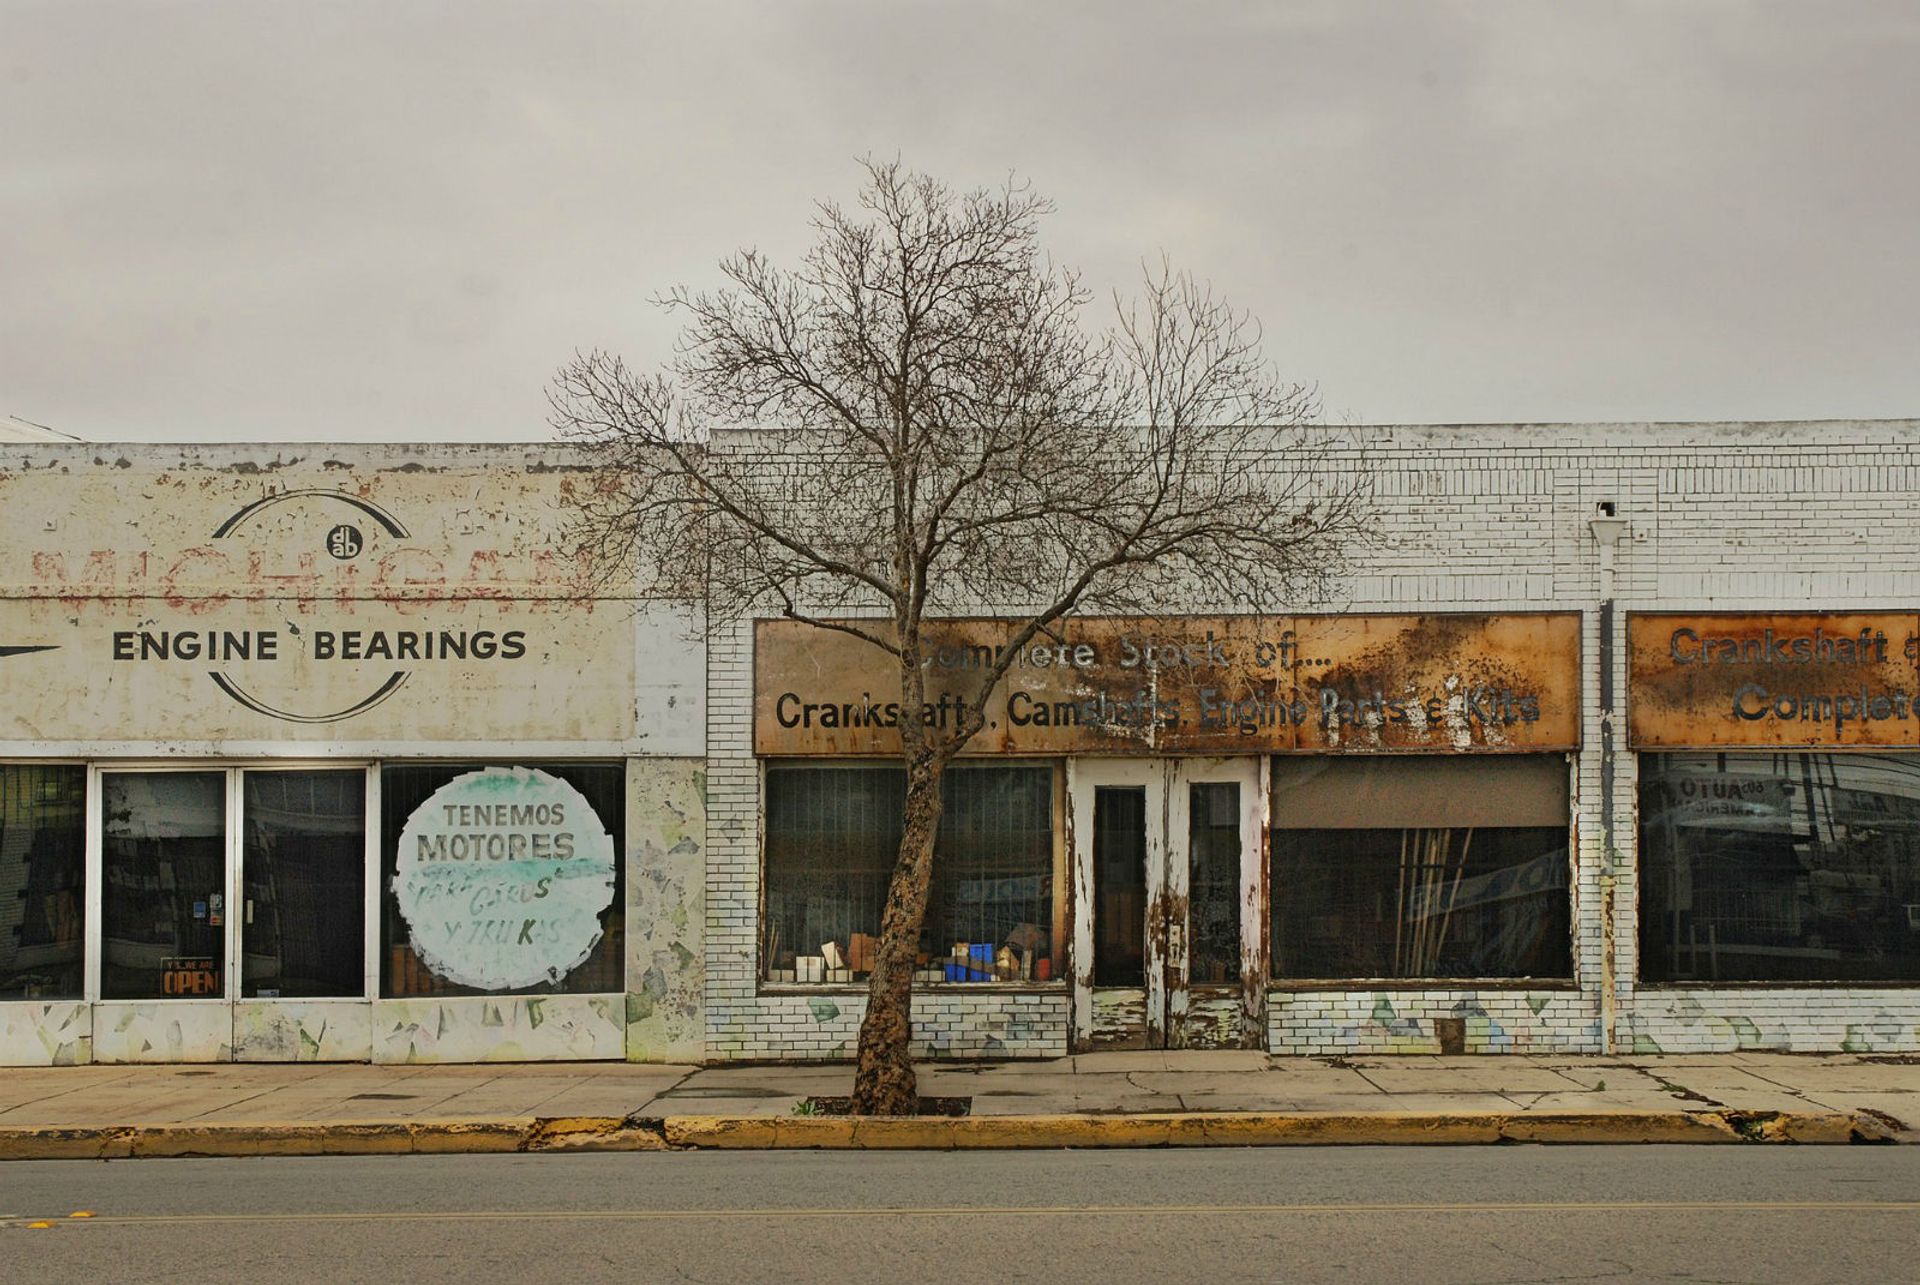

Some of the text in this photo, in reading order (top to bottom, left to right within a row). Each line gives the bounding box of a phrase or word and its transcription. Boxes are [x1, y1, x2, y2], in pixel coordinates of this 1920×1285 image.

[113, 631, 527, 660] ENGINE BEARINGS
[914, 636, 1095, 669] omlete
[1120, 631, 1230, 669] Stock
[1670, 627, 1888, 665] Crankshaft
[776, 691, 997, 730] Cranksaft,
[1202, 687, 1307, 735] Engine
[1320, 687, 1408, 727] Parts
[1462, 686, 1540, 727] Kits
[443, 803, 565, 826] TENEMOS
[417, 833, 575, 861] MOTORES
[164, 971, 220, 994] OPEN
